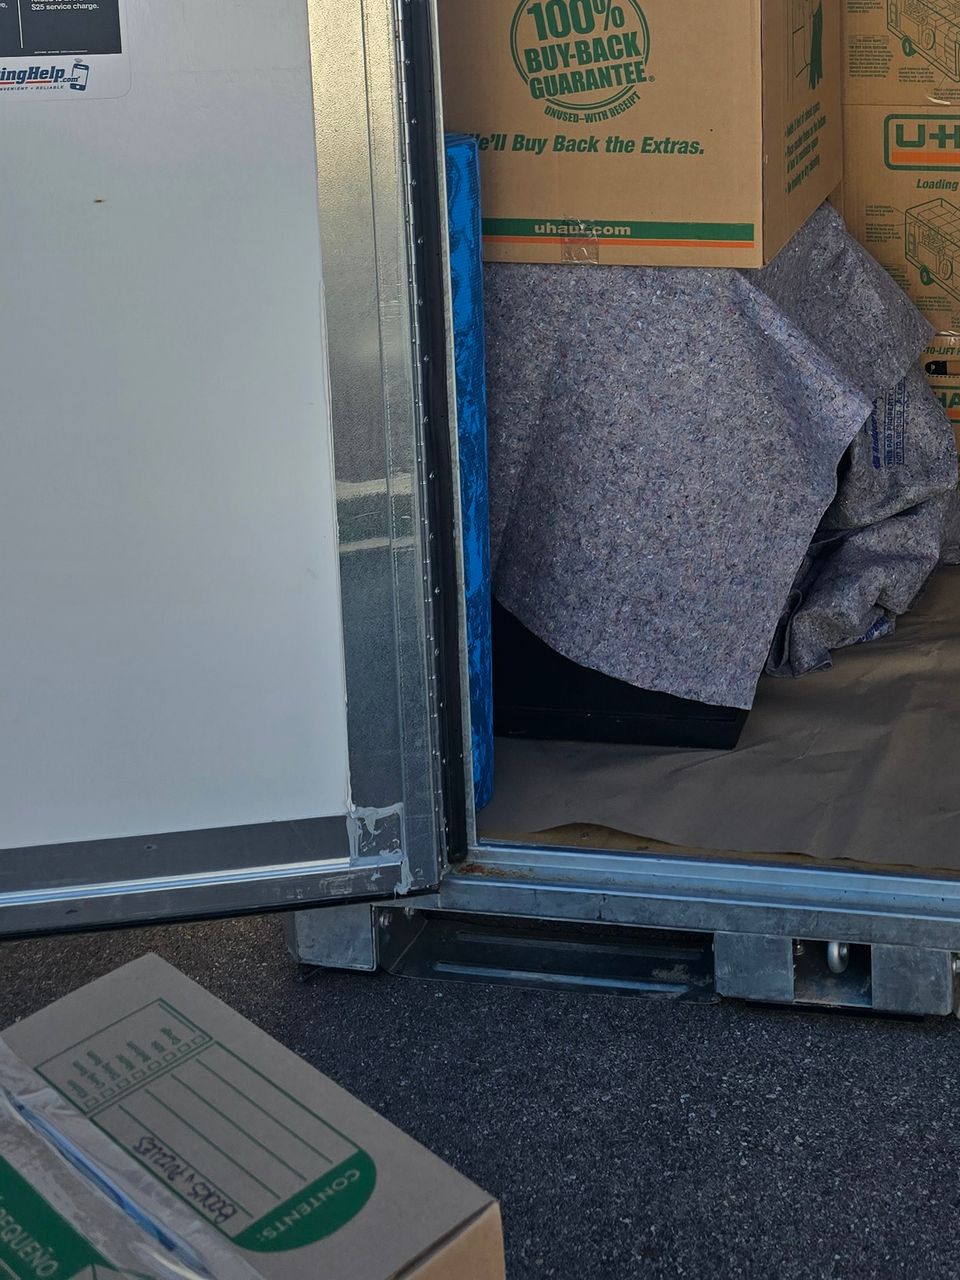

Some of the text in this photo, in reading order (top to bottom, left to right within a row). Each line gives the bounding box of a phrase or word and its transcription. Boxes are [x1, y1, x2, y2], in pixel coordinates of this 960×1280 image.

[524, 31, 642, 74] BUY-BACK
[529, 61, 648, 101] GUARANTEE
[608, 91, 641, 118] RECEIPT
[512, 134, 704, 156] Buy Back the Extras.
[916, 179, 959, 192] Loading
[534, 222, 631, 235] uhaul.com
[258, 1168, 360, 1242] CONTENTS:
